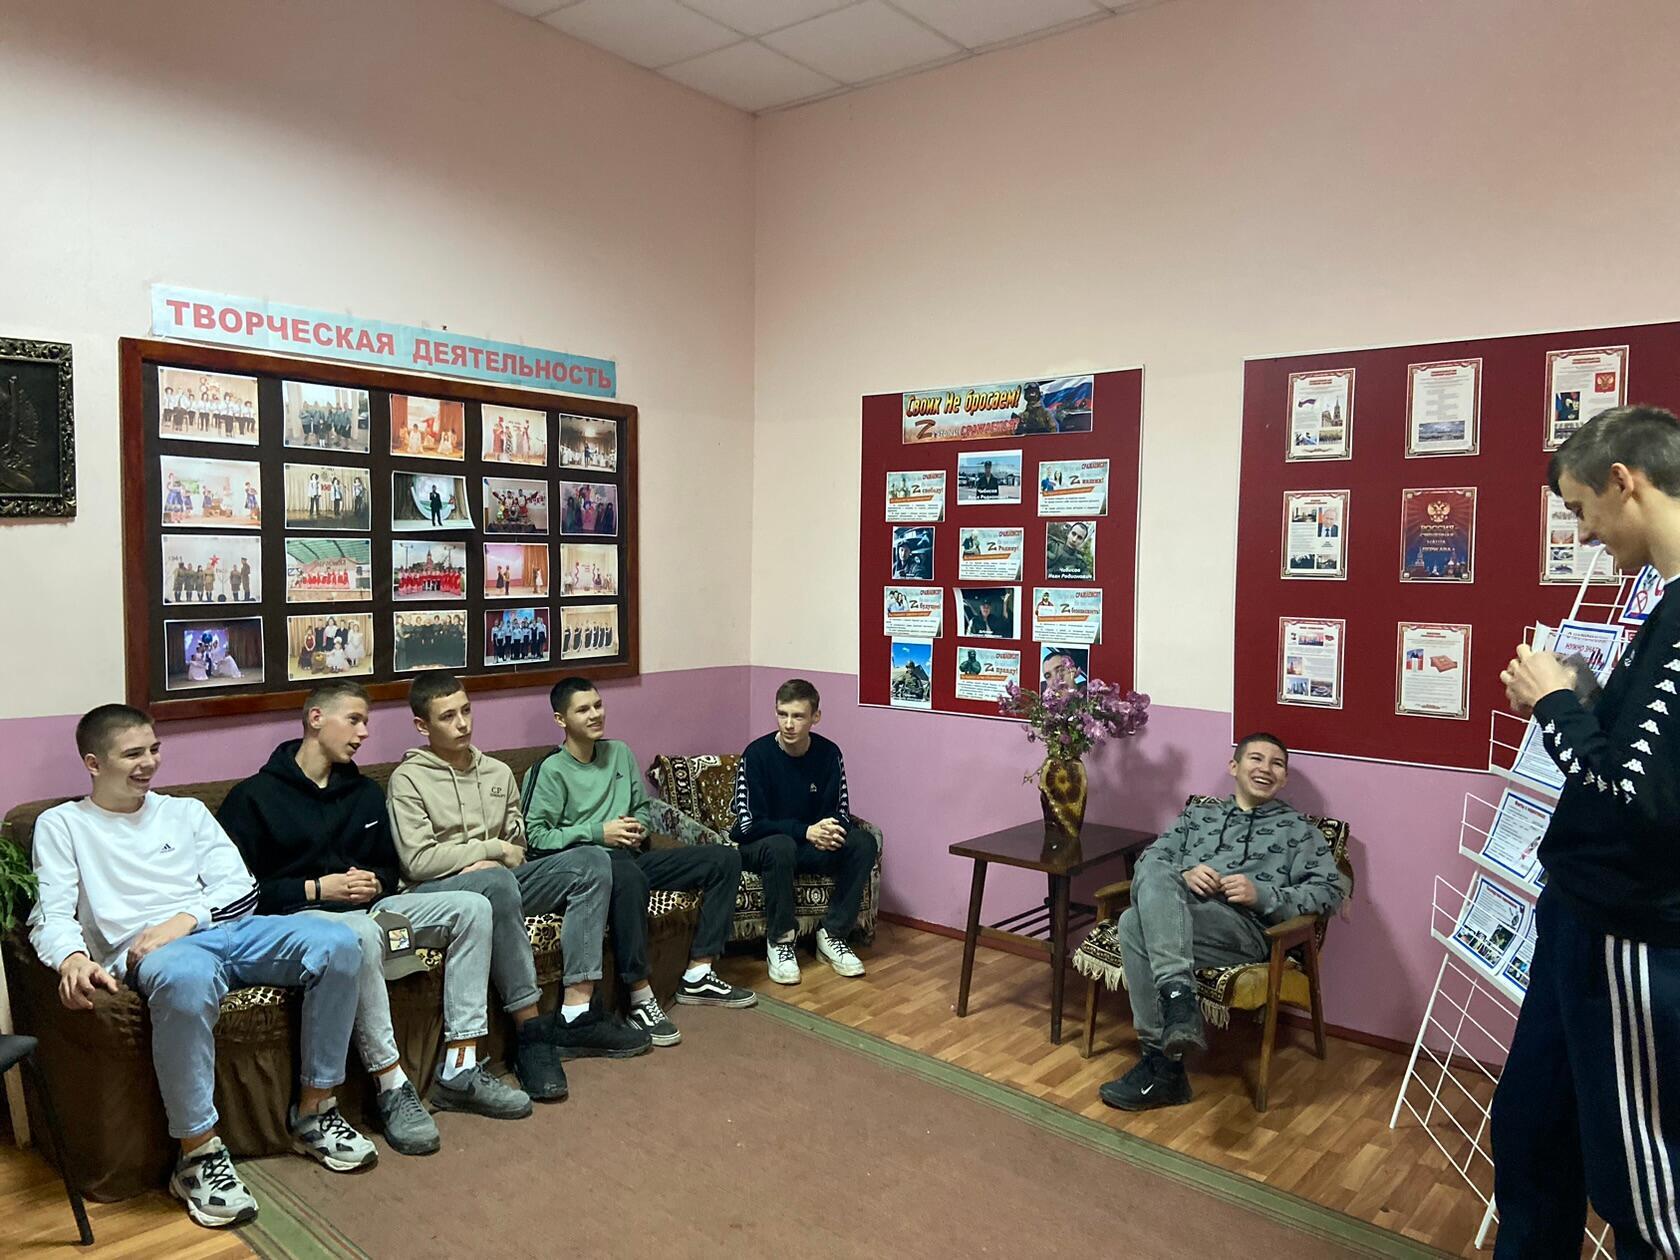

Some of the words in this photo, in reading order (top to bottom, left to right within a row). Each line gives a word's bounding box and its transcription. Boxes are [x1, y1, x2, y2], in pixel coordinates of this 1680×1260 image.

[166, 299, 395, 356] ТВОРЧЕСКАЯ
[412, 338, 612, 389] ДЕЯТЕЛЬНОСТЬ
[906, 395, 942, 417] Своих
[944, 391, 961, 414] Не
[964, 384, 1022, 416] бросаем!
